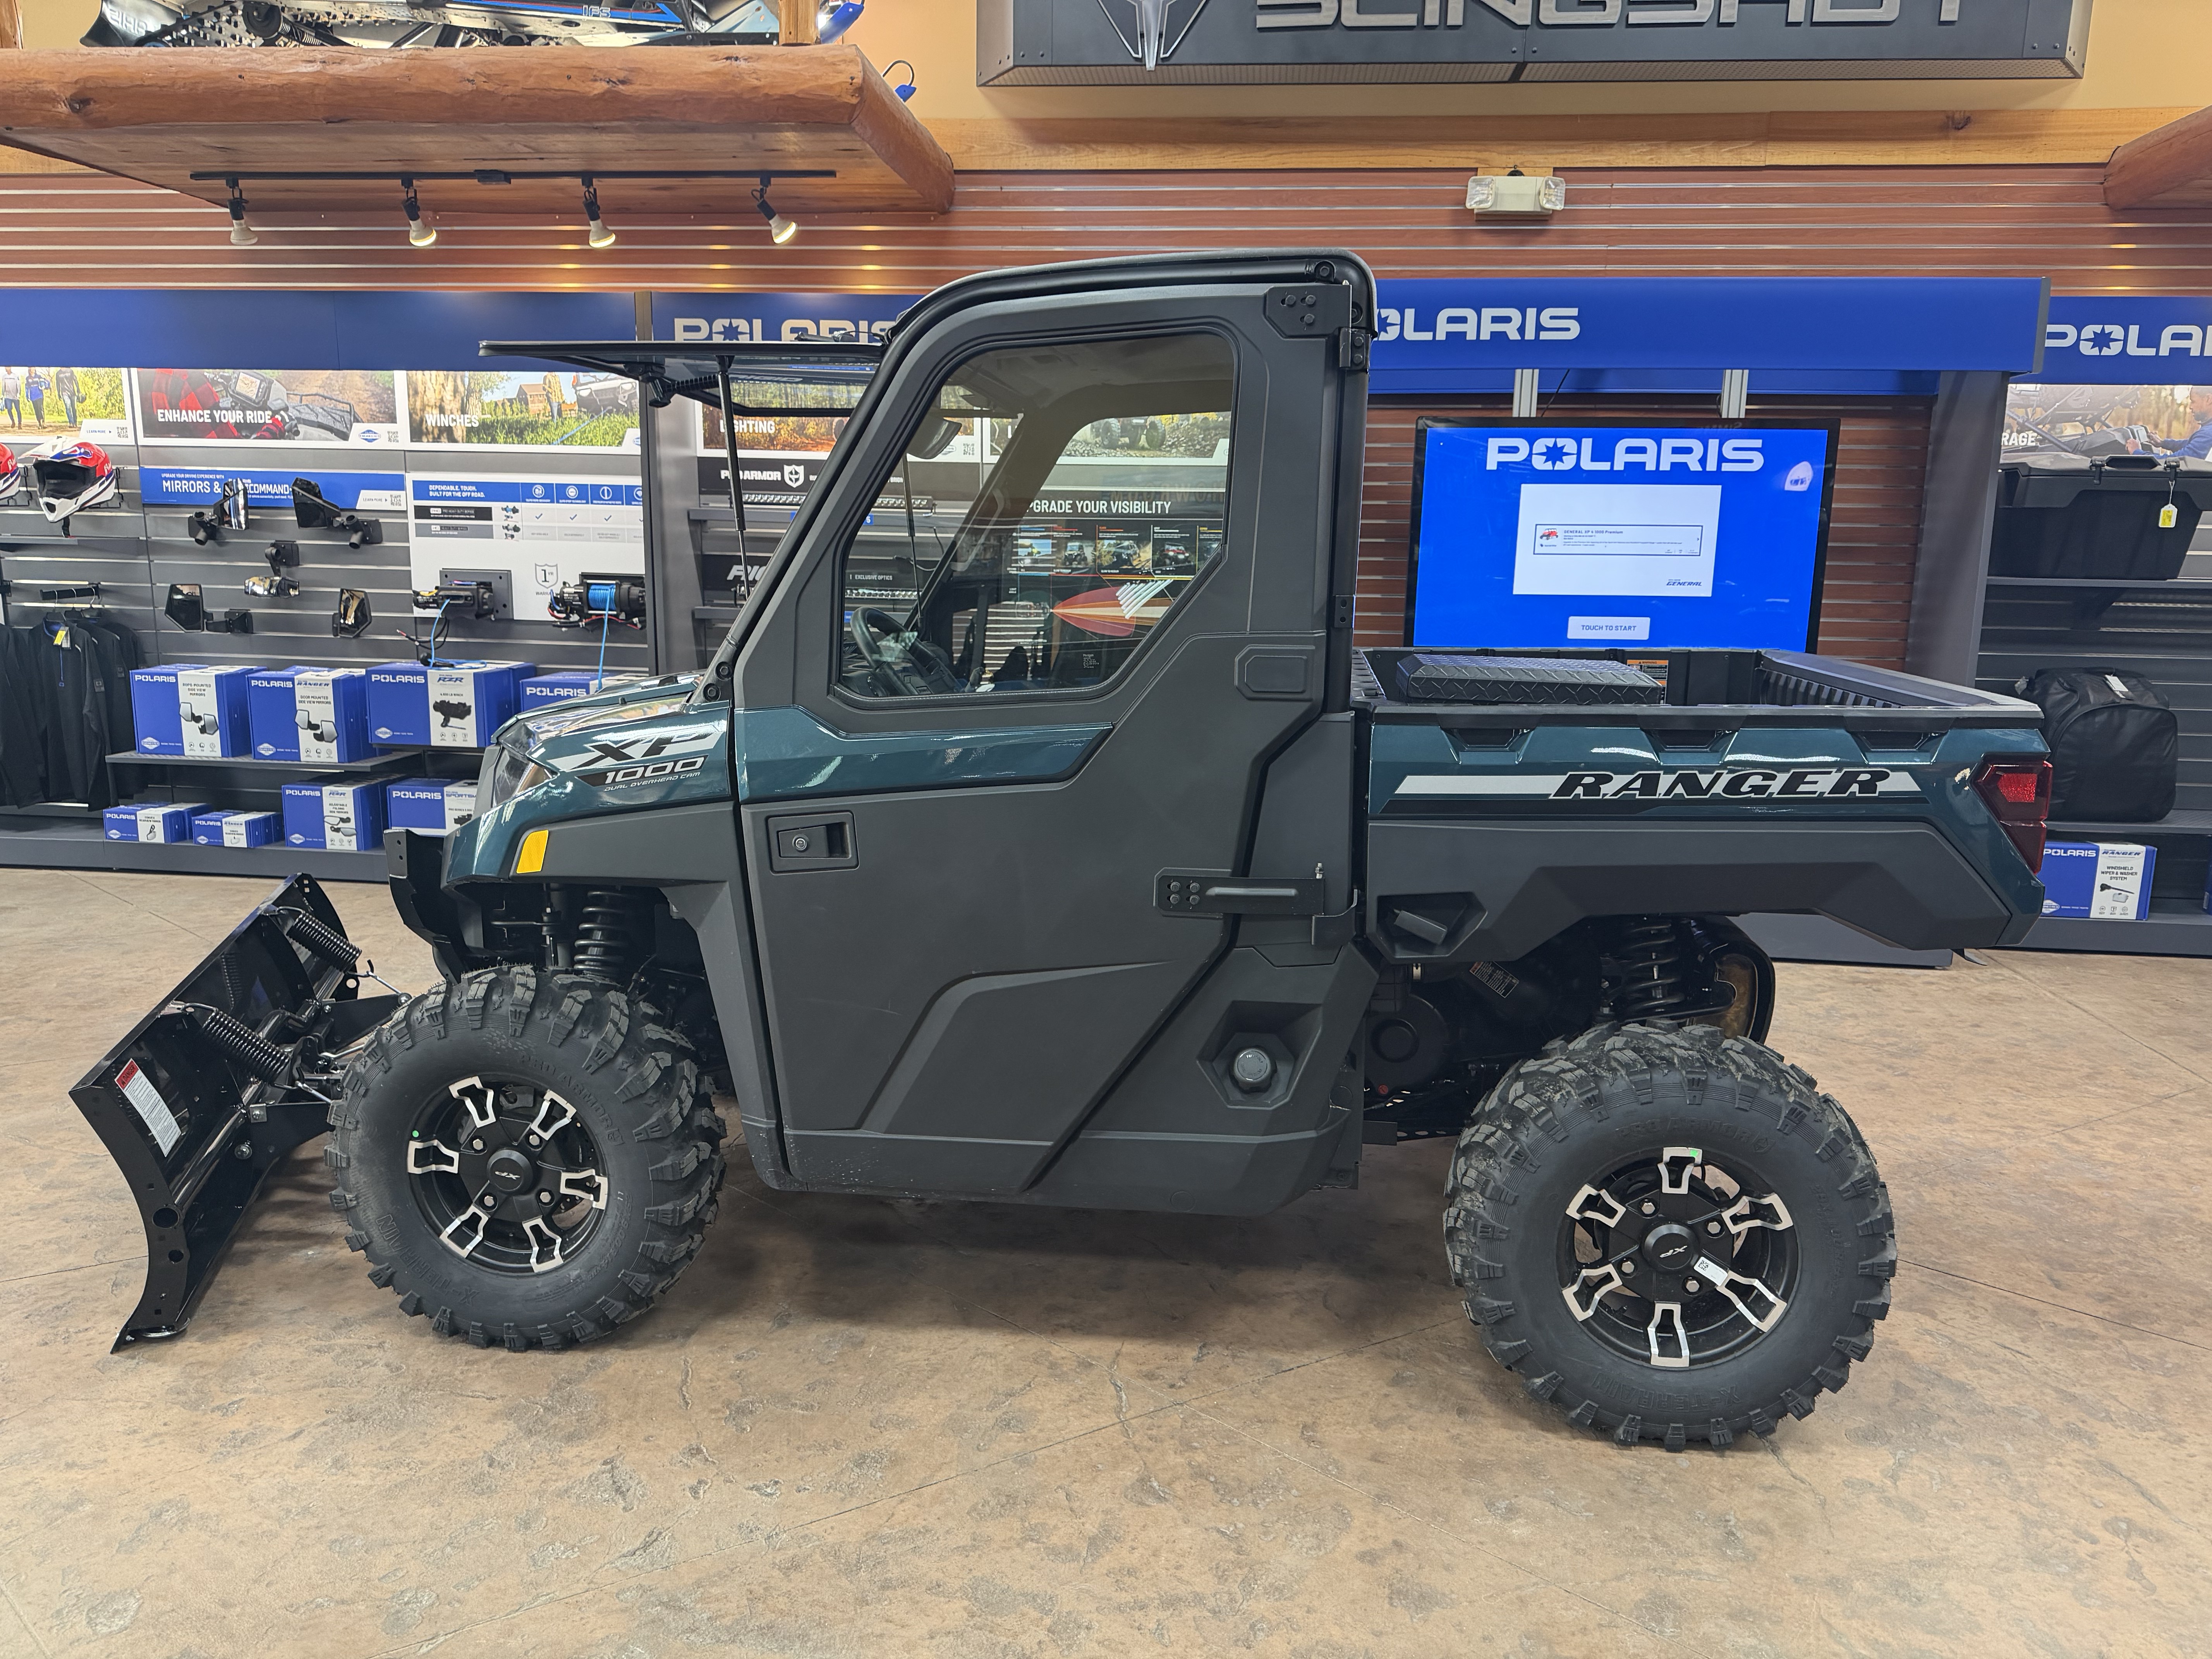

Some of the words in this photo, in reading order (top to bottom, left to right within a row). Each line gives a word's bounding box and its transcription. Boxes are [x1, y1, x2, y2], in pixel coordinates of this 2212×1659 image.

[1377, 308, 1580, 341] OLARIS
[2045, 325, 2212, 356] POLA
[158, 409, 211, 422] ENHANCE
[213, 410, 244, 423] YOUR
[247, 410, 272, 424] RIDE
[426, 414, 479, 427] WINCHES
[720, 419, 775, 433] LGHTING
[2001, 432, 2036, 446] RAGE
[1486, 438, 1764, 472] POLARIS
[744, 470, 781, 481] ARMOR
[163, 480, 210, 493] MIRRORS
[213, 481, 222, 493] &
[245, 484, 292, 494] COMMAND
[1027, 500, 1073, 513] GRADE
[1076, 500, 1107, 513] YOUR
[1110, 501, 1171, 514] VISIBILITY
[371, 674, 425, 683] POLARIS
[526, 687, 587, 697] POLARIS
[571, 726, 719, 769] XP
[605, 757, 705, 784] 1000
[630, 776, 679, 787] OVERHEAD
[1551, 769, 1894, 799] RANGER
[392, 790, 442, 800] POLARIS
[2044, 849, 2096, 857] POLARIS
